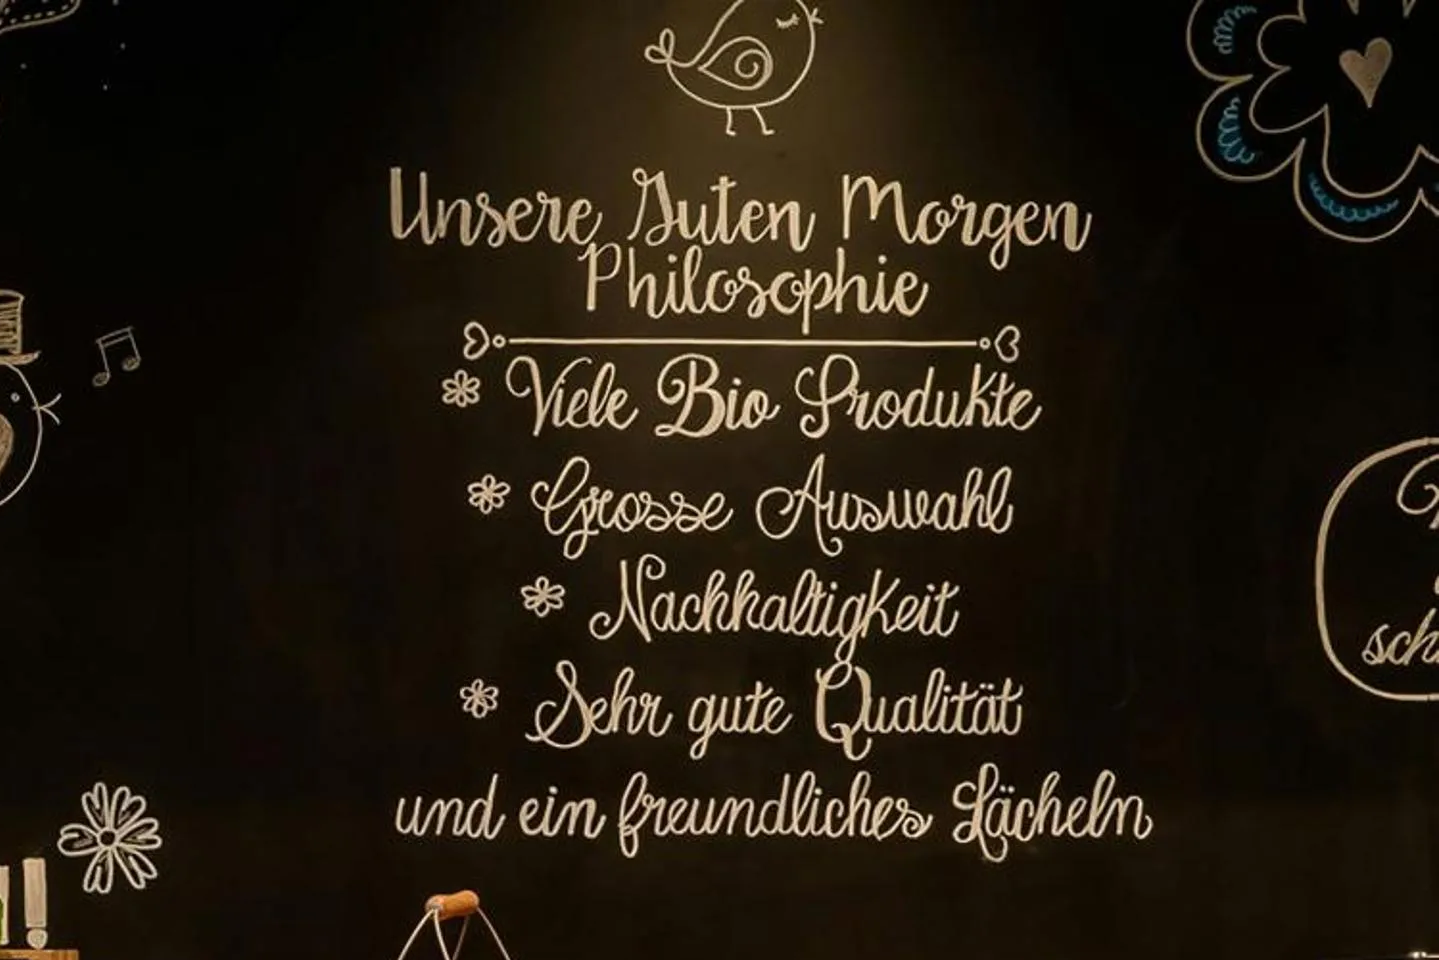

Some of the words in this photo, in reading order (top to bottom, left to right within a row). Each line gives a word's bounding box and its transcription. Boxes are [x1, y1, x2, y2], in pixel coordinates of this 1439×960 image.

[390, 167, 602, 247] Unsere
[627, 168, 815, 251] Guten
[842, 174, 1091, 270] Morgen
[579, 243, 929, 334] Philosophie
[505, 355, 639, 438] Viele
[655, 354, 780, 437] Bio
[795, 354, 1041, 438] Produkte
[531, 457, 733, 560] Grosse
[756, 454, 1013, 557] Auswahl
[525, 660, 674, 749] Sehr
[688, 680, 794, 760] gute
[814, 660, 1023, 760] Qualität
[395, 774, 505, 839] und
[519, 789, 607, 838] ein
[619, 771, 932, 858] freundliches
[951, 762, 1153, 863] Lächeln
